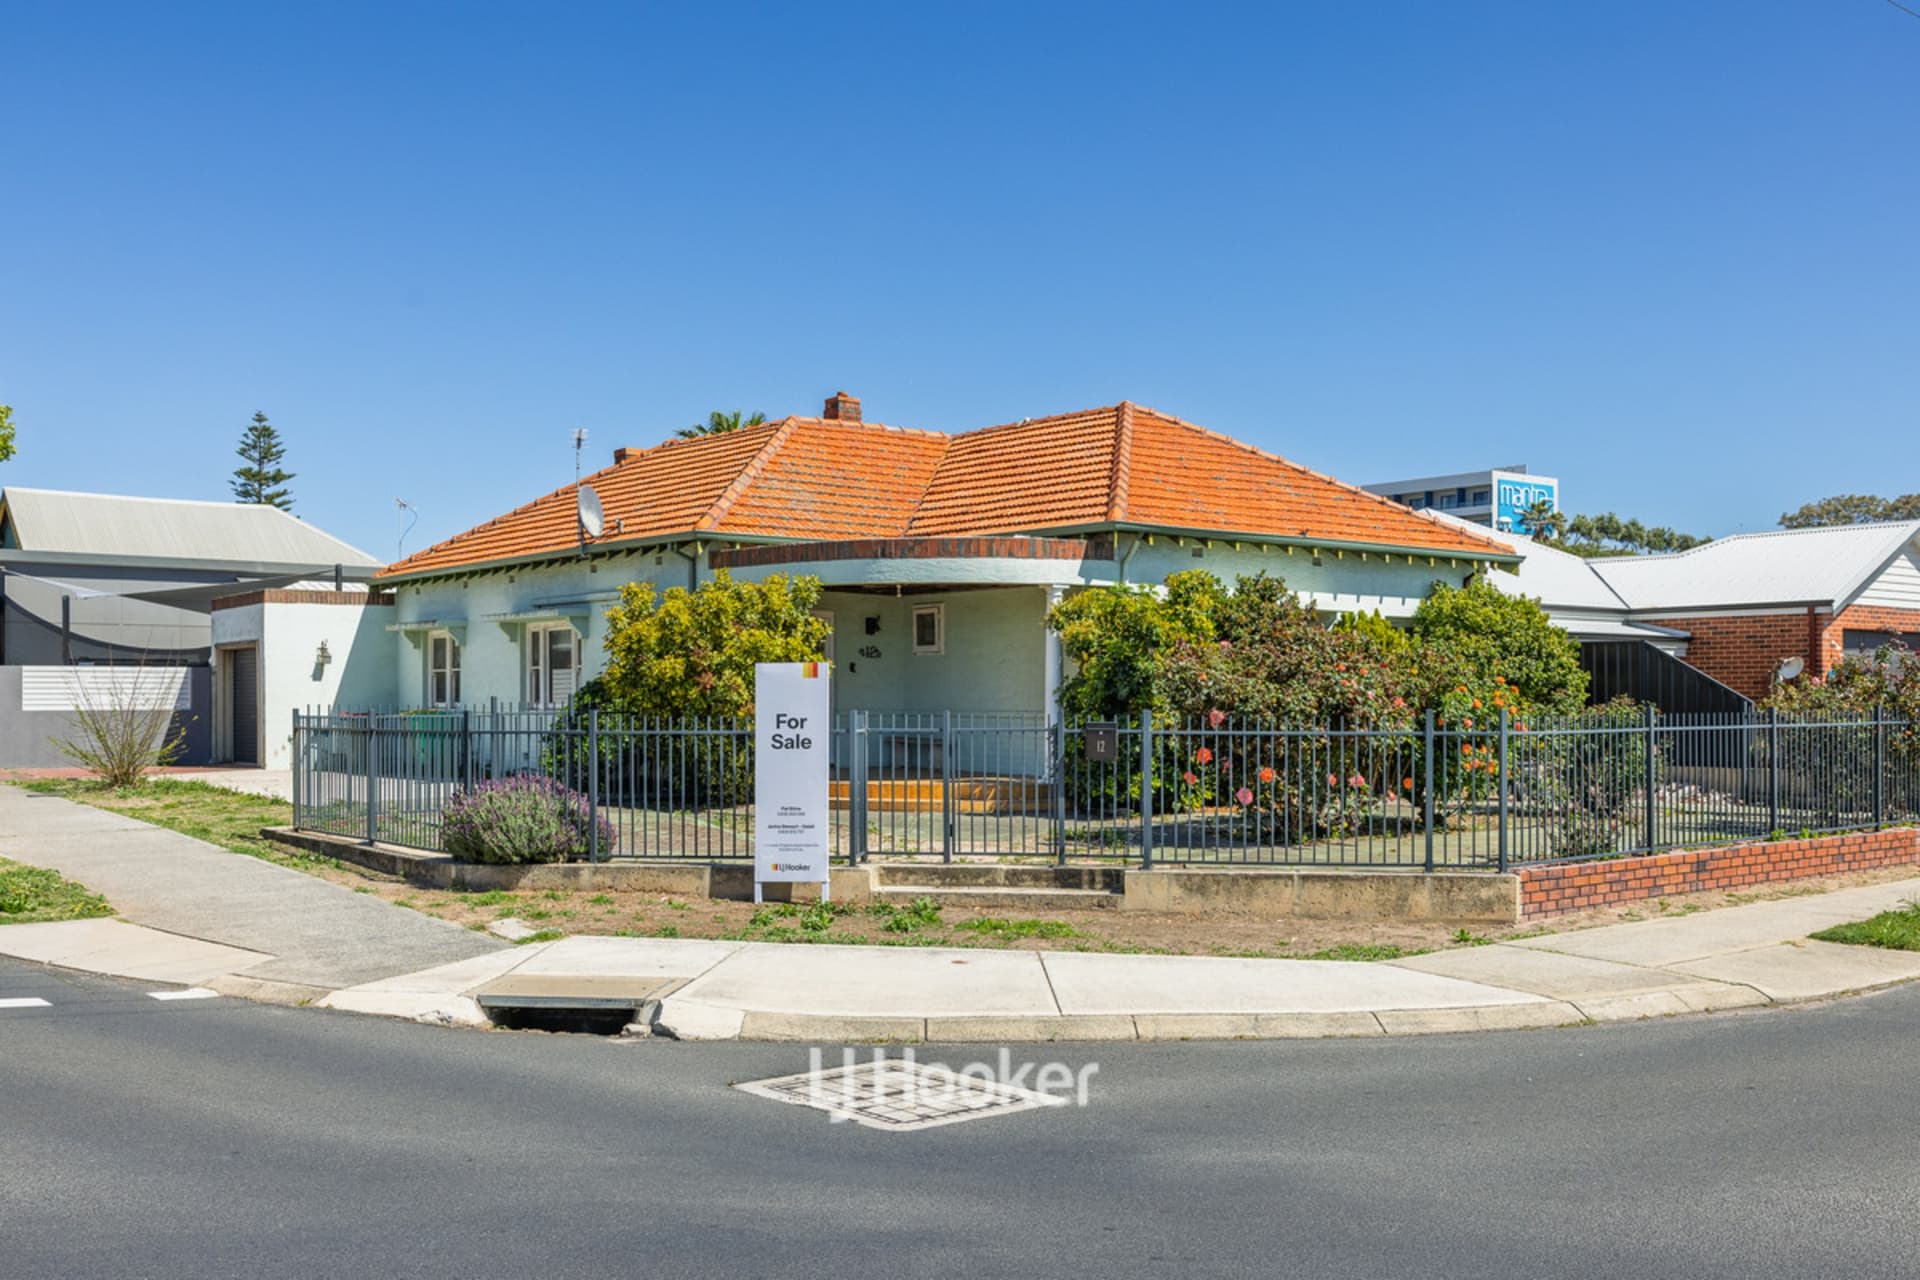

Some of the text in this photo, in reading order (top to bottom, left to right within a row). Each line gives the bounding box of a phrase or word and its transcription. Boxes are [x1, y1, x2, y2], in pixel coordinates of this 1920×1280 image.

[776, 713, 807, 729] For
[771, 733, 812, 750] Sale
[1097, 740, 1105, 752] 12
